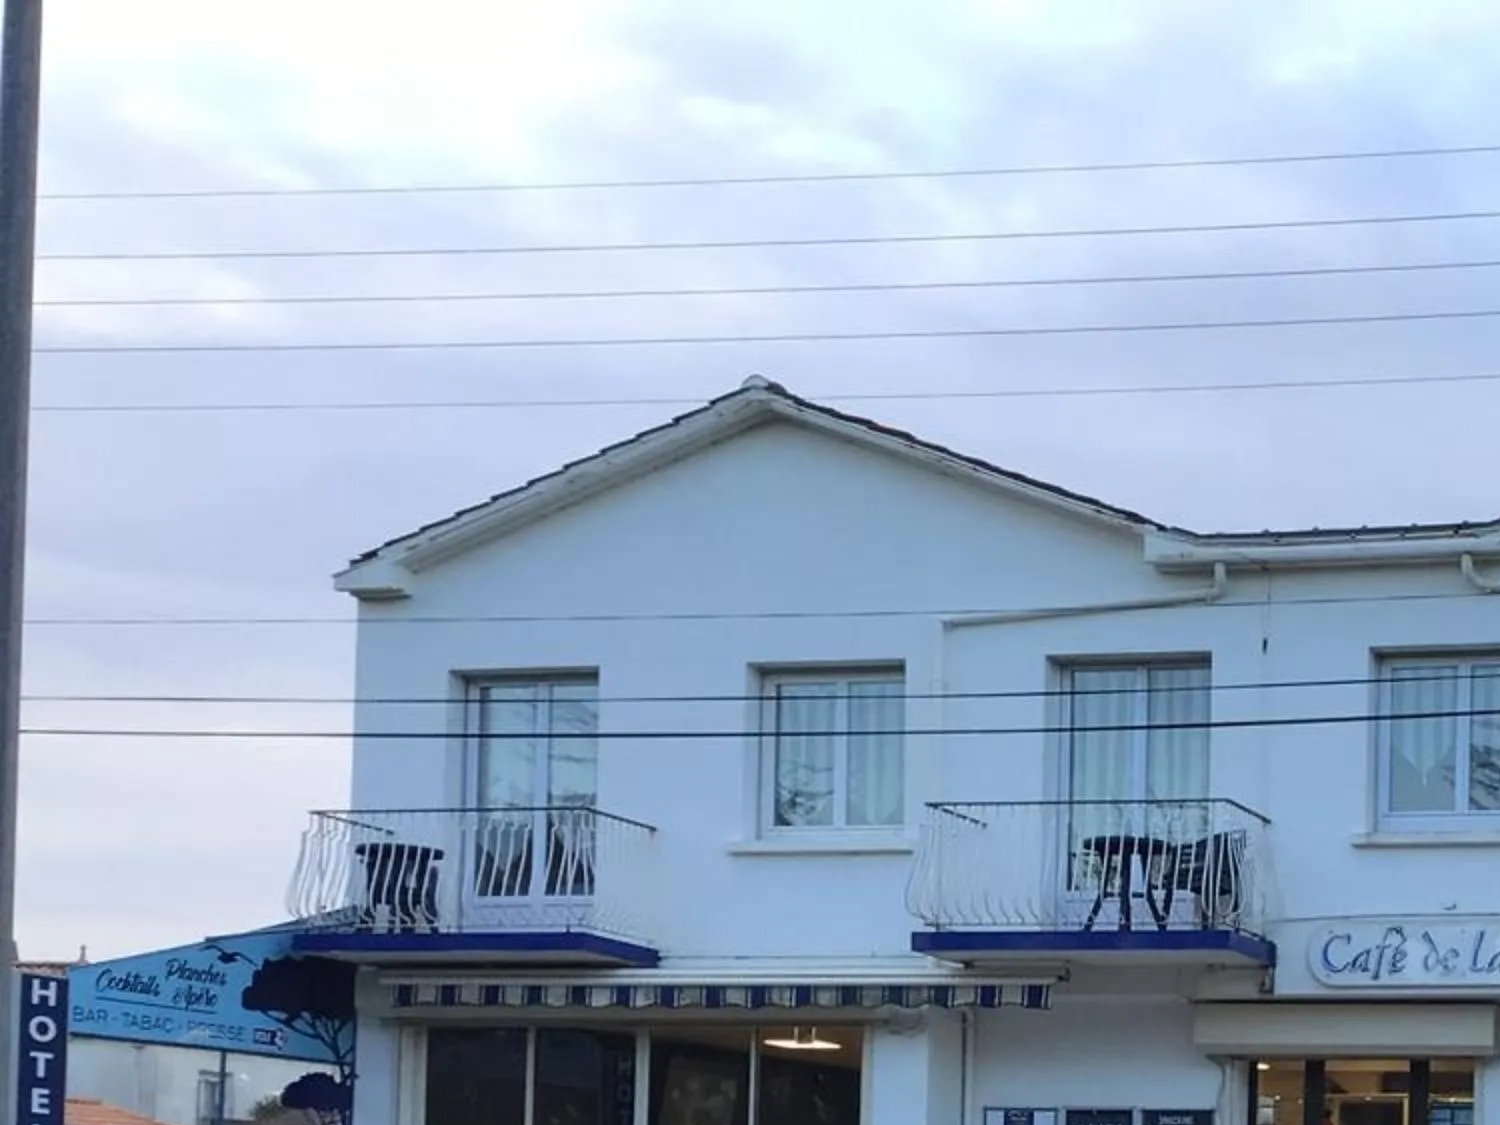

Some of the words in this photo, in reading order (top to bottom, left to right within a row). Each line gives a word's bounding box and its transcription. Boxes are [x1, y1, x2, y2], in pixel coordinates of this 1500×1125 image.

[1322, 926, 1408, 981] Café
[1422, 930, 1460, 974] de
[95, 967, 161, 997] Cocktails
[72, 1005, 108, 1024] BAR
[122, 1011, 174, 1034] TABAC
